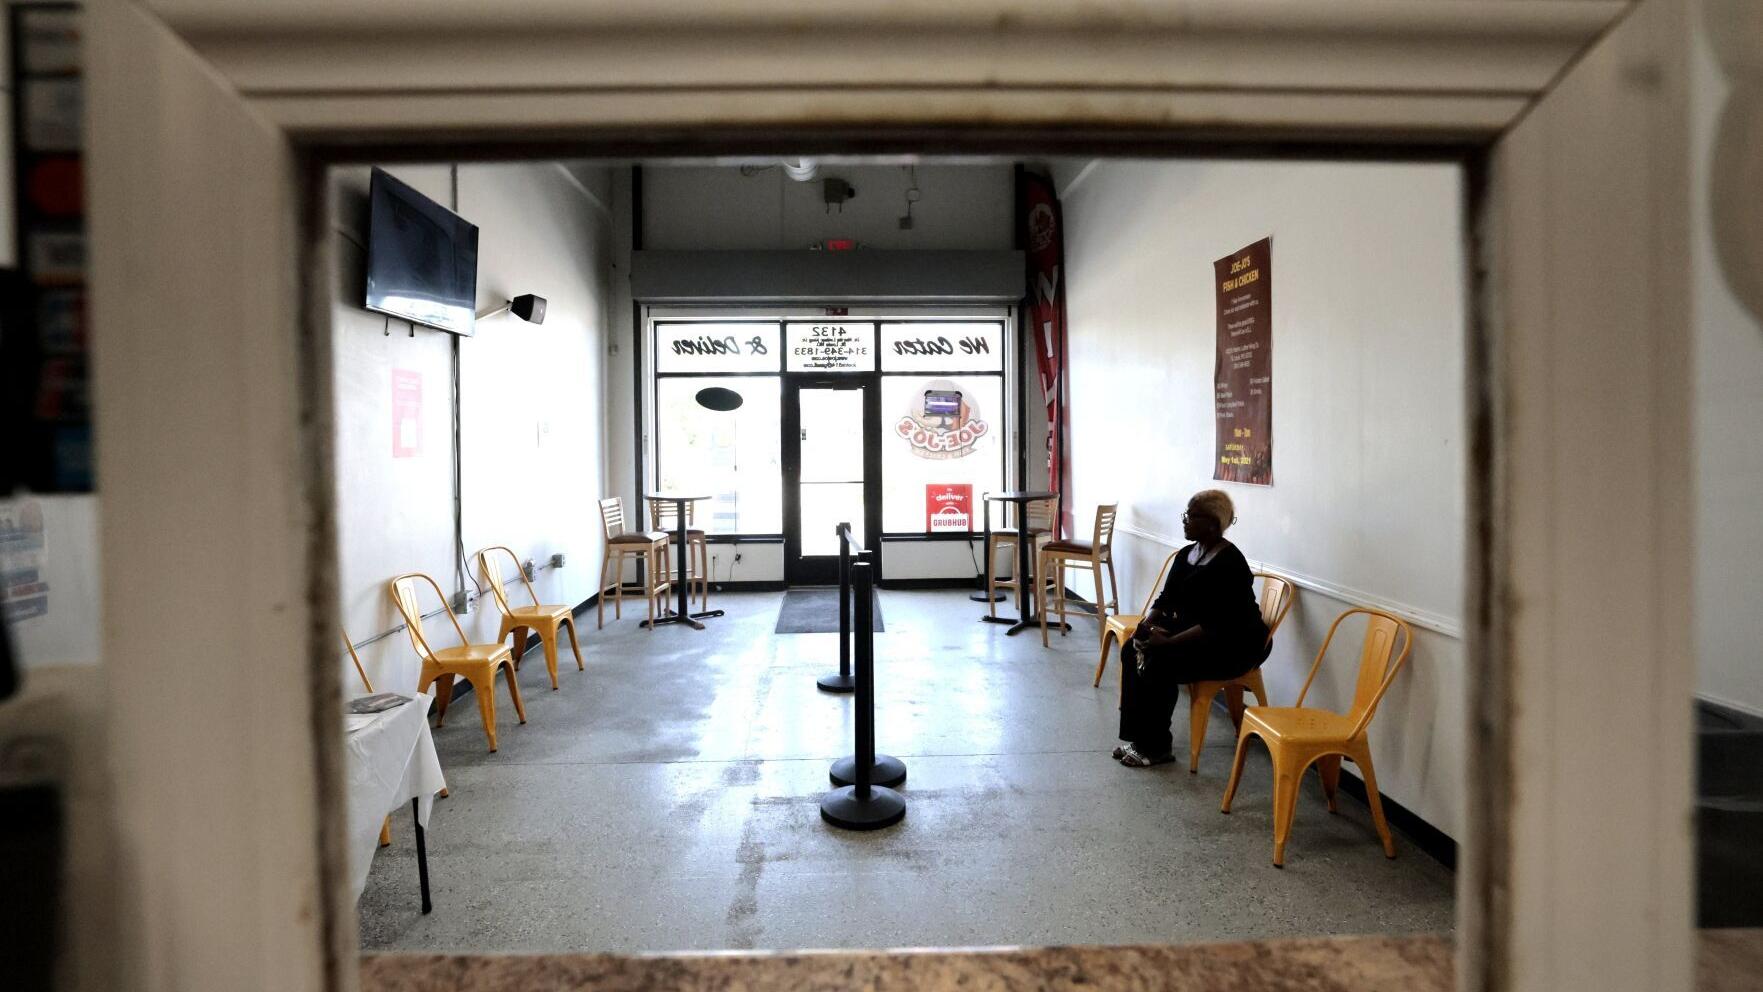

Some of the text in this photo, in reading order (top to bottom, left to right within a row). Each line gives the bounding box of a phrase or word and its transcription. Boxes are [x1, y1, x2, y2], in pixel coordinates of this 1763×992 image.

[1223, 280, 1235, 292] FISH
[1239, 269, 1259, 287] CHICKEN
[936, 493, 964, 501] deliver
